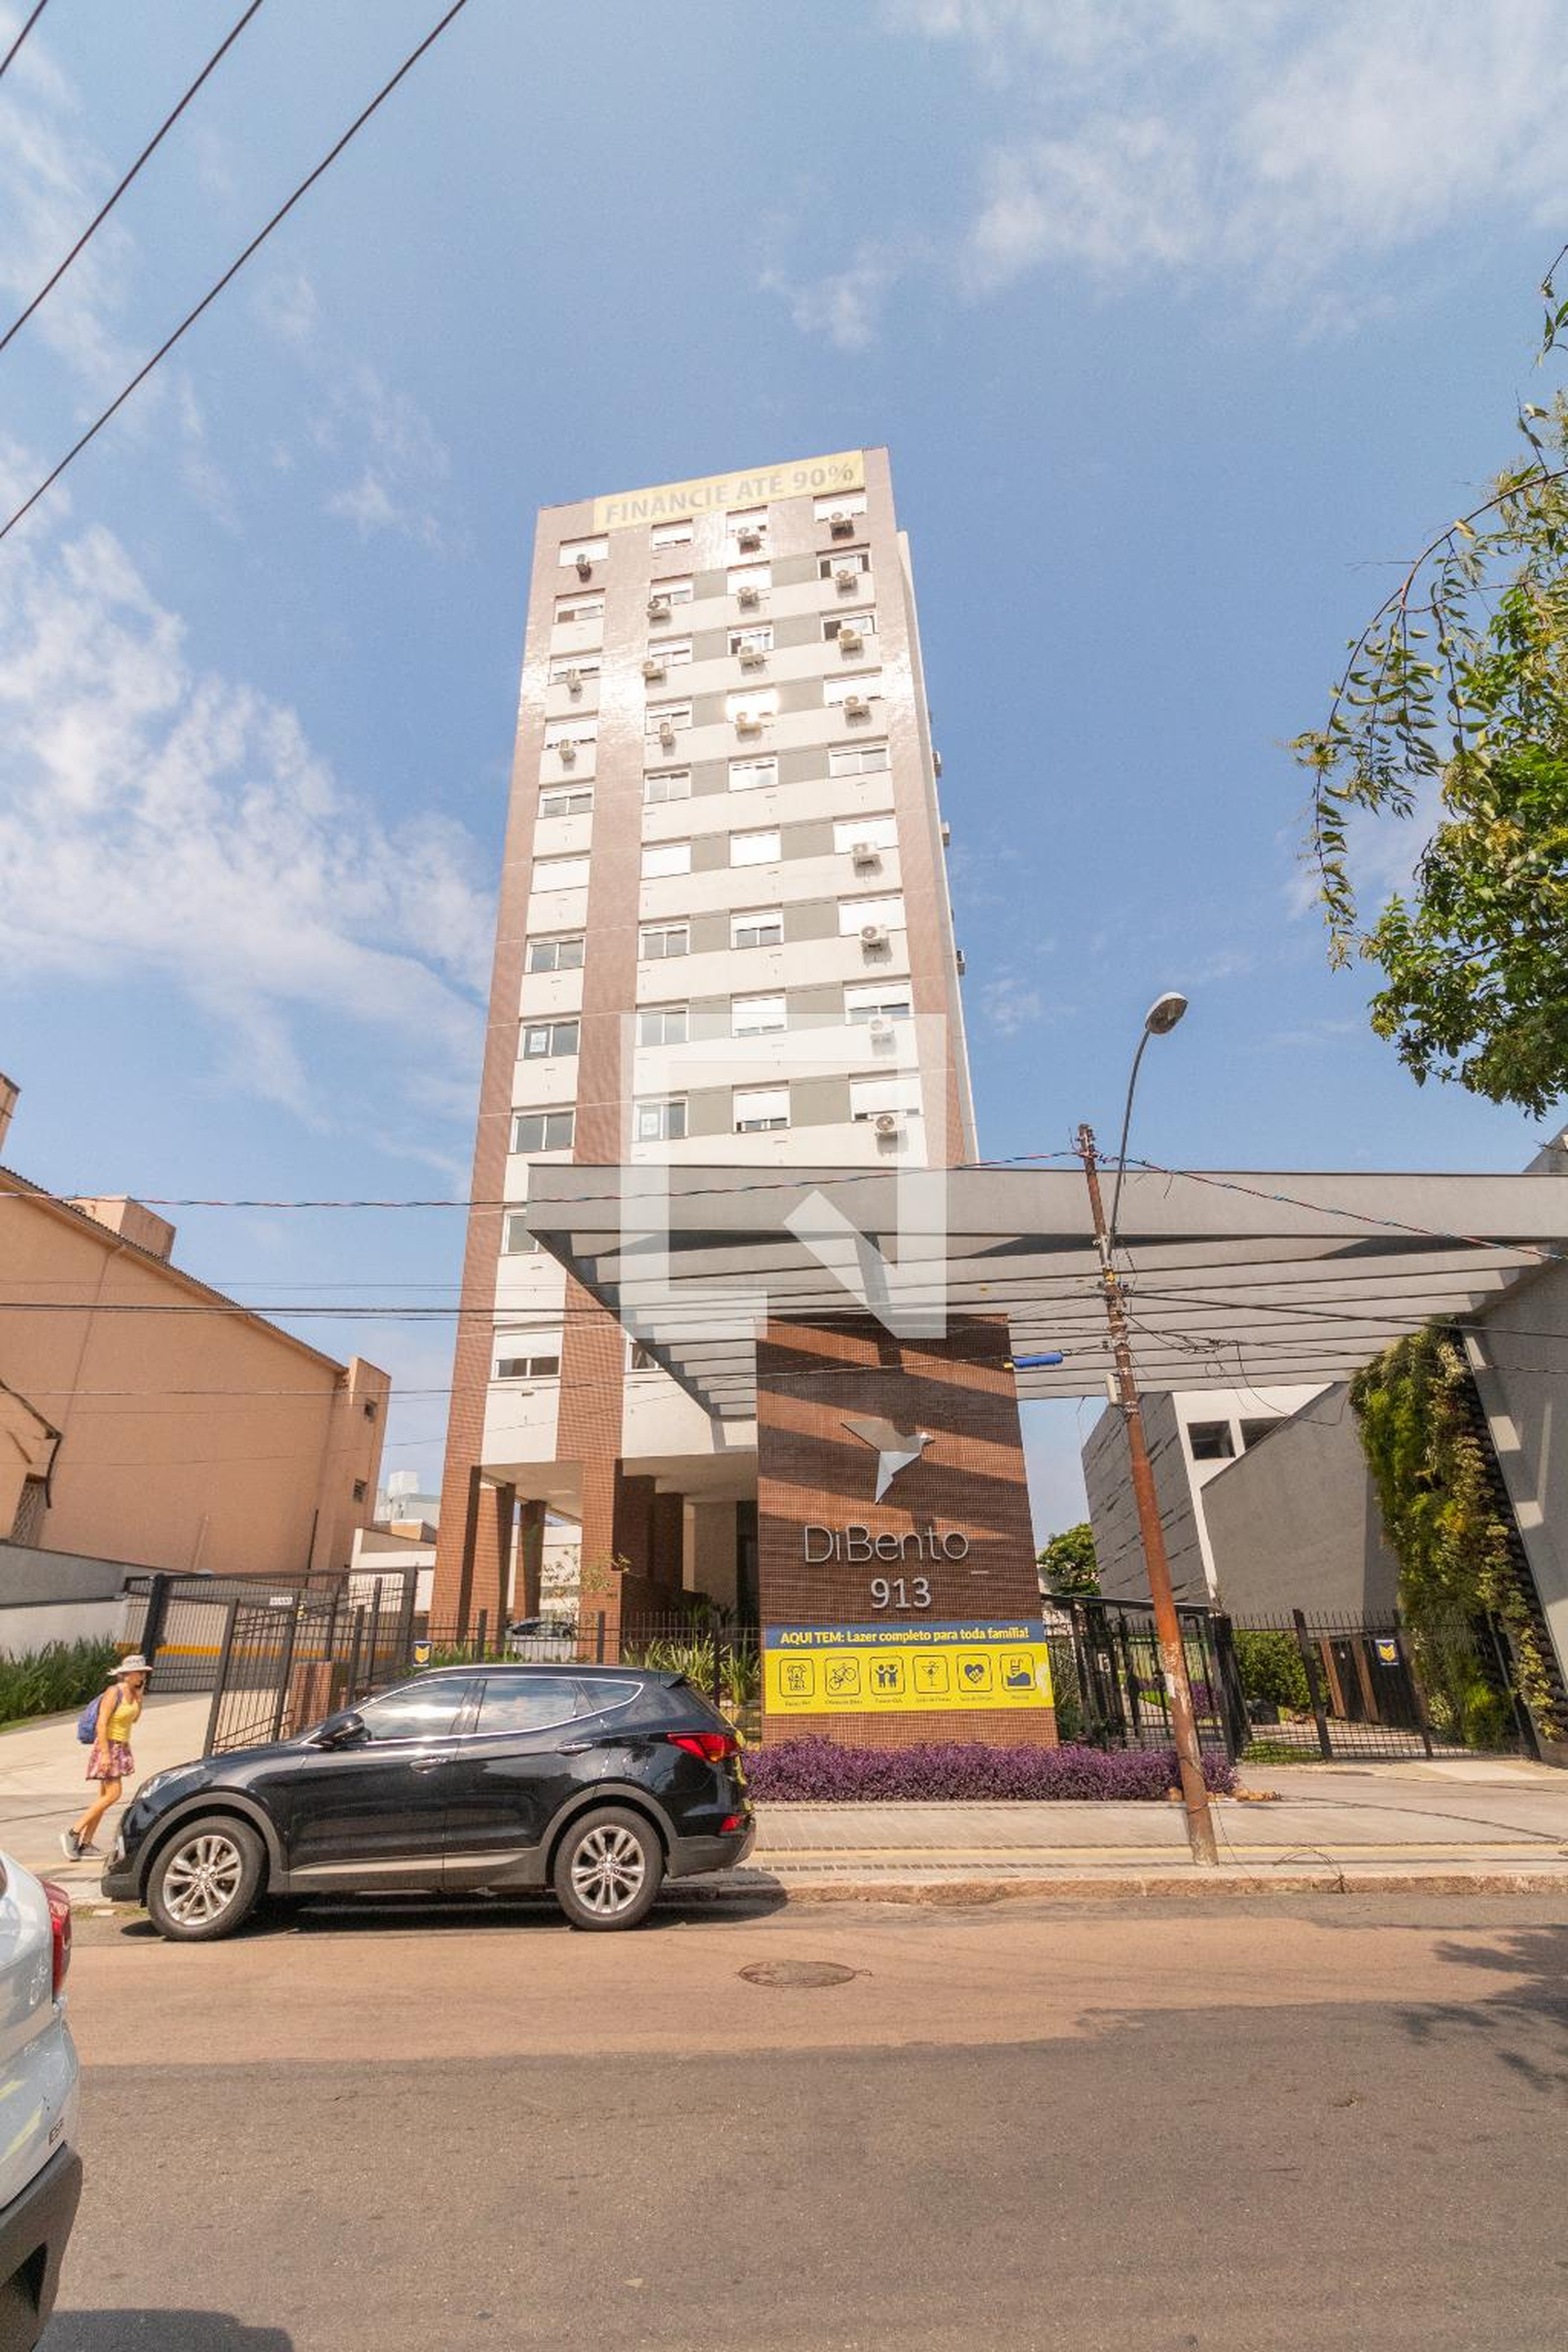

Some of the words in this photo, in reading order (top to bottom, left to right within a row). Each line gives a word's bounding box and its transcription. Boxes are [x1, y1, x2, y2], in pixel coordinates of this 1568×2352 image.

[606, 484, 727, 524] FINANCIE
[793, 463, 854, 490] 90%
[803, 1525, 969, 1563] DiBento
[870, 1577, 932, 1609] 913
[780, 1631, 812, 1645] AQUI
[814, 1631, 844, 1644] TEM:
[847, 1630, 877, 1642] Lazer
[879, 1629, 931, 1644] completo
[933, 1630, 958, 1642] para
[960, 1627, 986, 1639] toda
